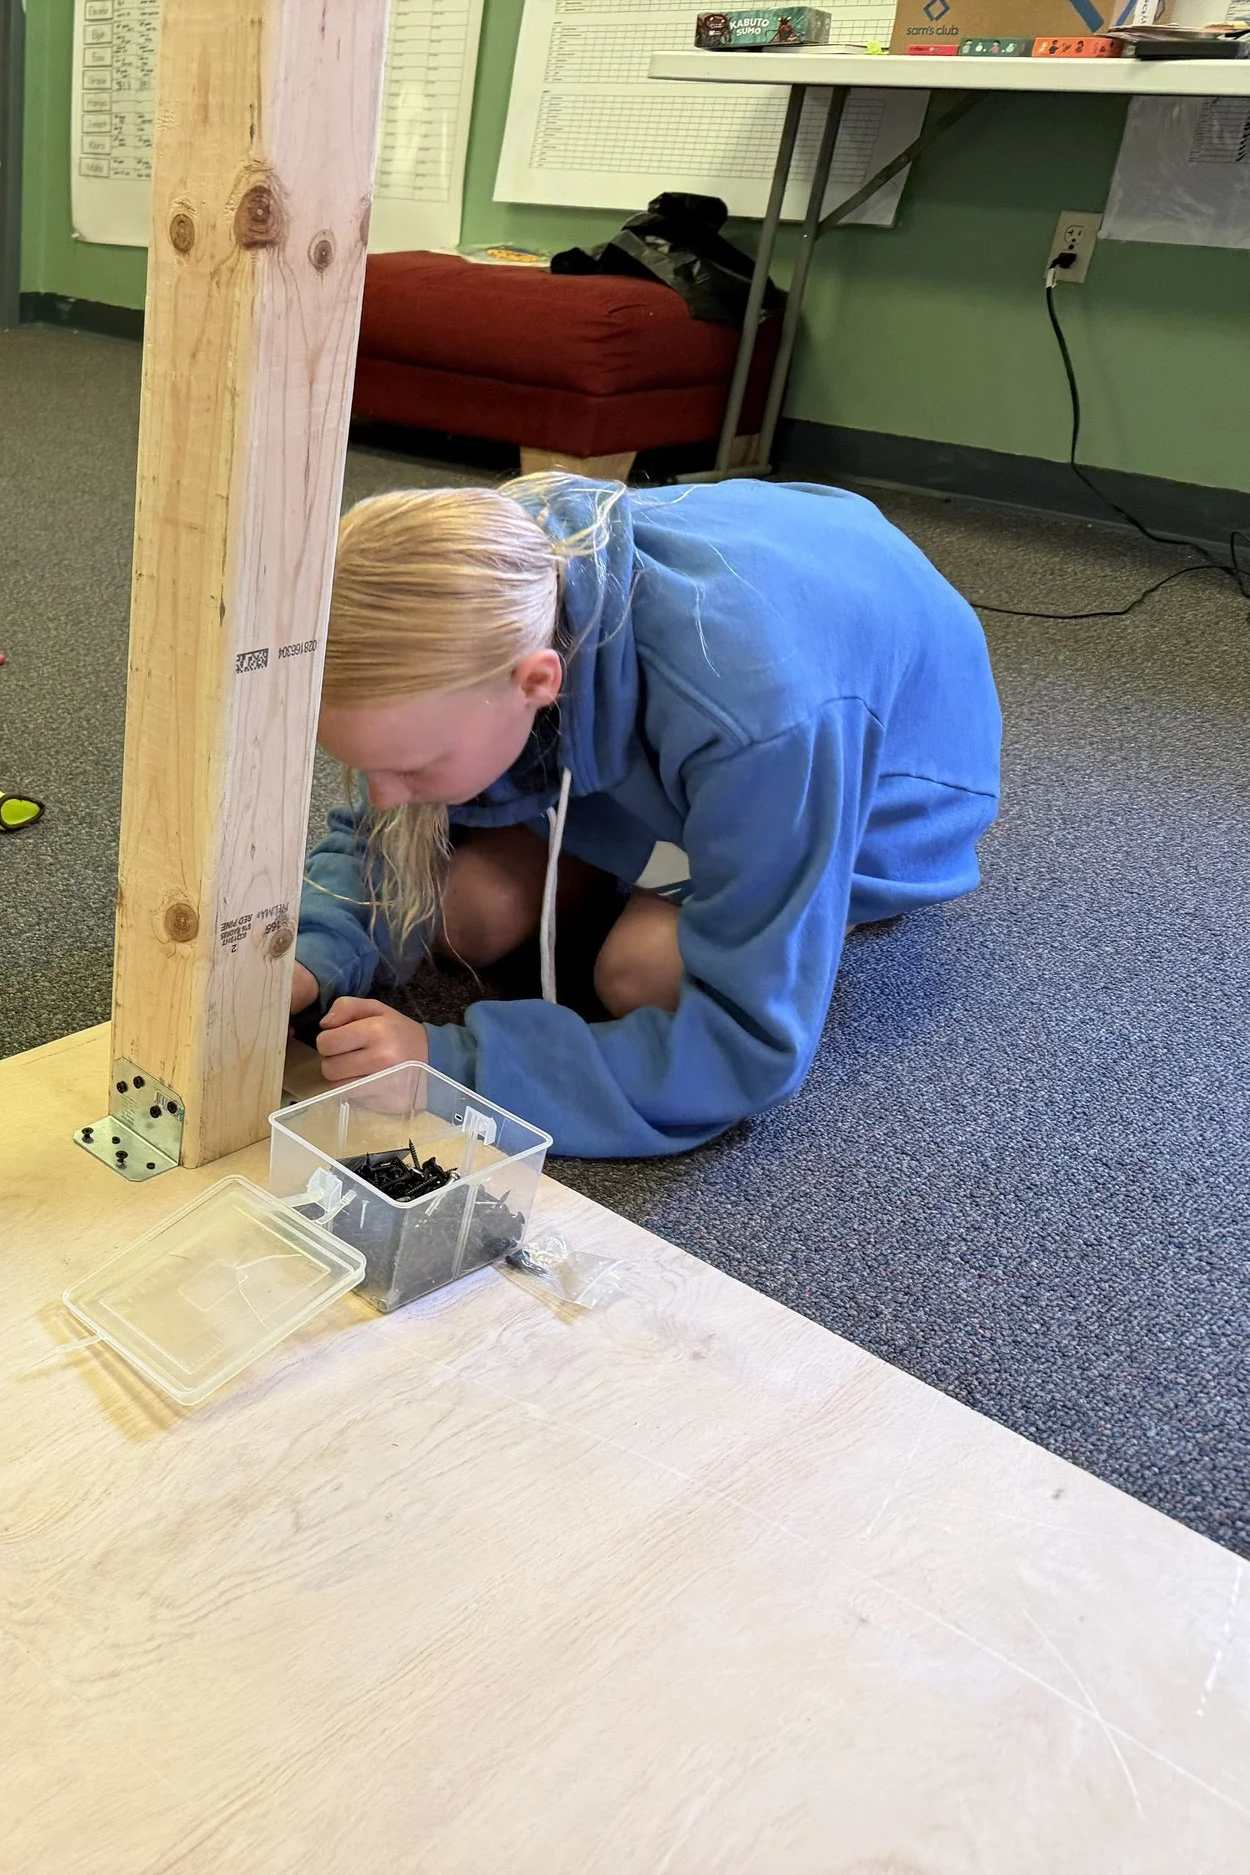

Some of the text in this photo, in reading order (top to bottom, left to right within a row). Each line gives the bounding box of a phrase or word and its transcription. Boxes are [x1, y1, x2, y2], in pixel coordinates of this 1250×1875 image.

[730, 17, 770, 30] KABUTO
[736, 27, 762, 36] SUMO
[906, 25, 959, 36] sam's club
[221, 913, 253, 931] RED PINE
[231, 943, 238, 953] 2
